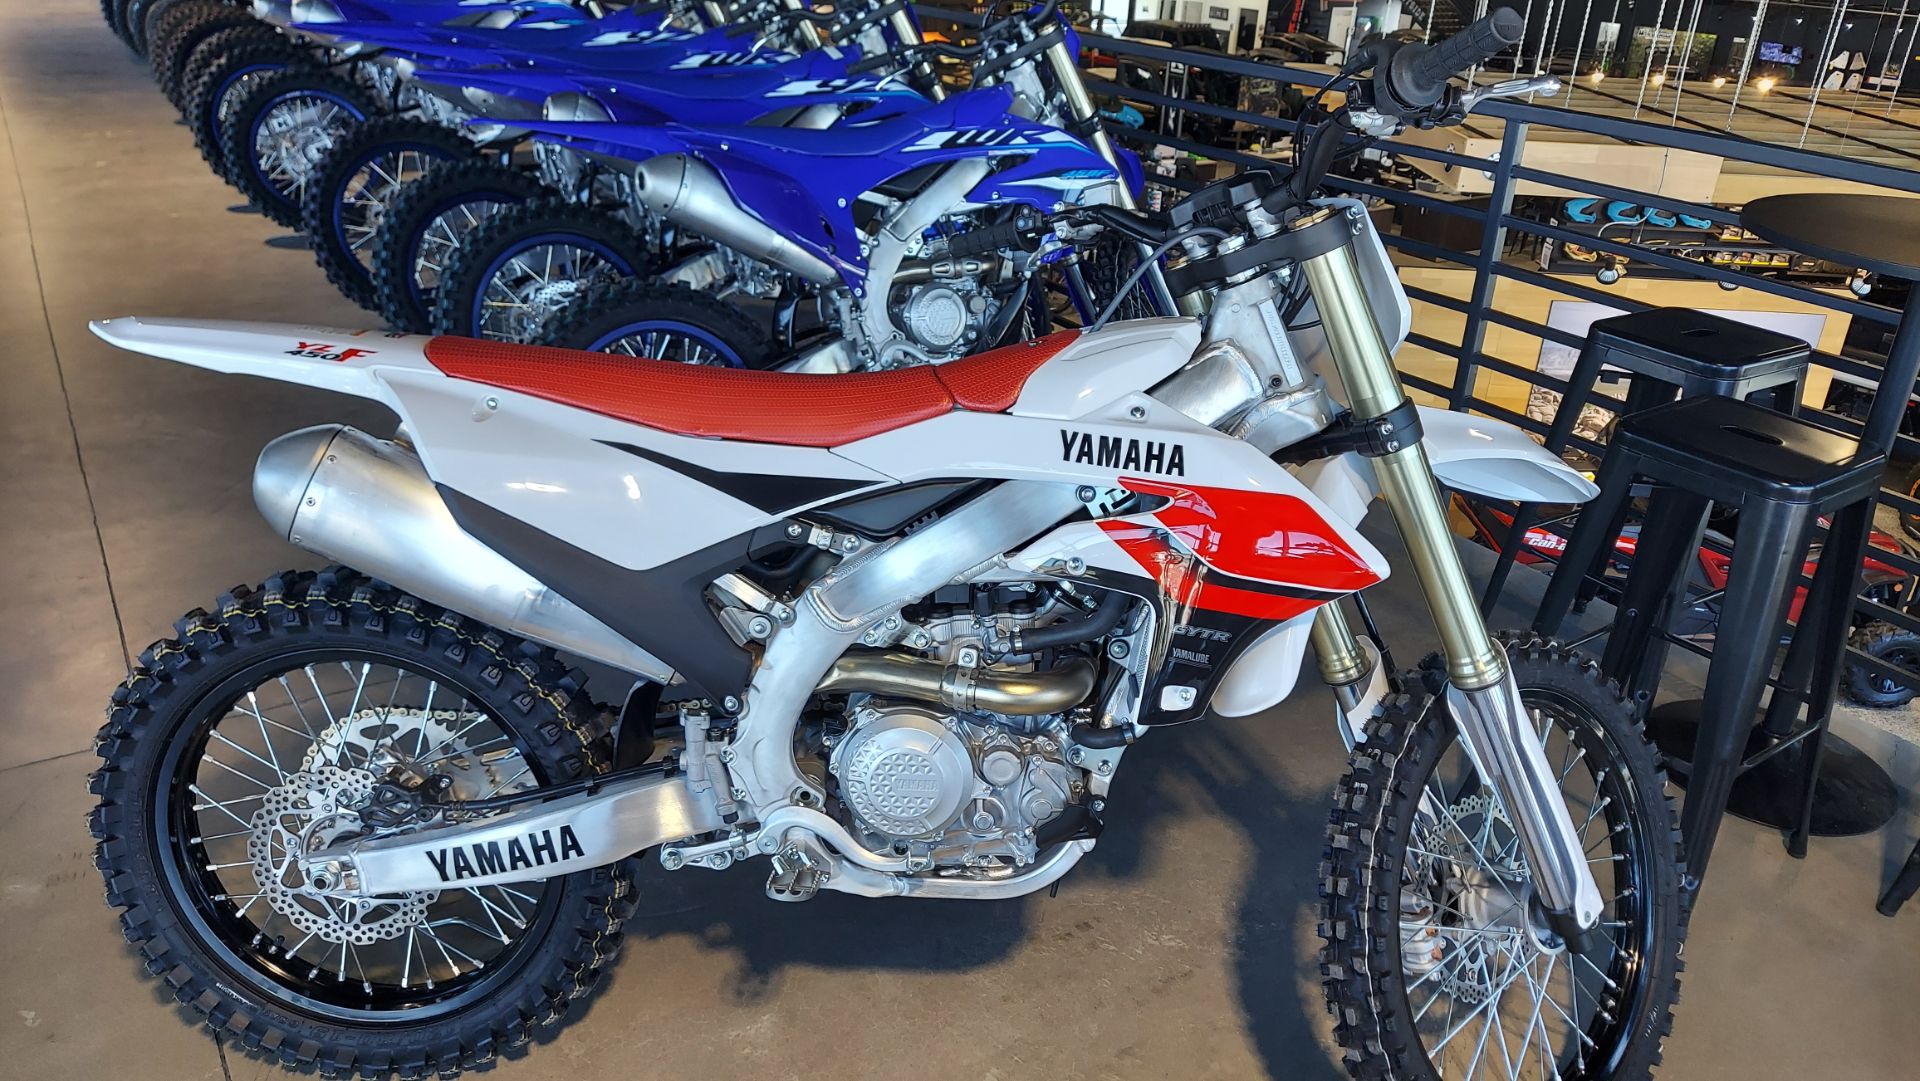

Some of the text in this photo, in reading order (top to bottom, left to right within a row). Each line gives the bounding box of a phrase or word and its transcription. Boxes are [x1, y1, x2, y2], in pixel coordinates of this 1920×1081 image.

[1060, 429, 1185, 477] YAMAHA
[1173, 624, 1232, 642] GYTR
[1173, 647, 1211, 663] YAMALUBE
[425, 824, 585, 882] YAMAHA
